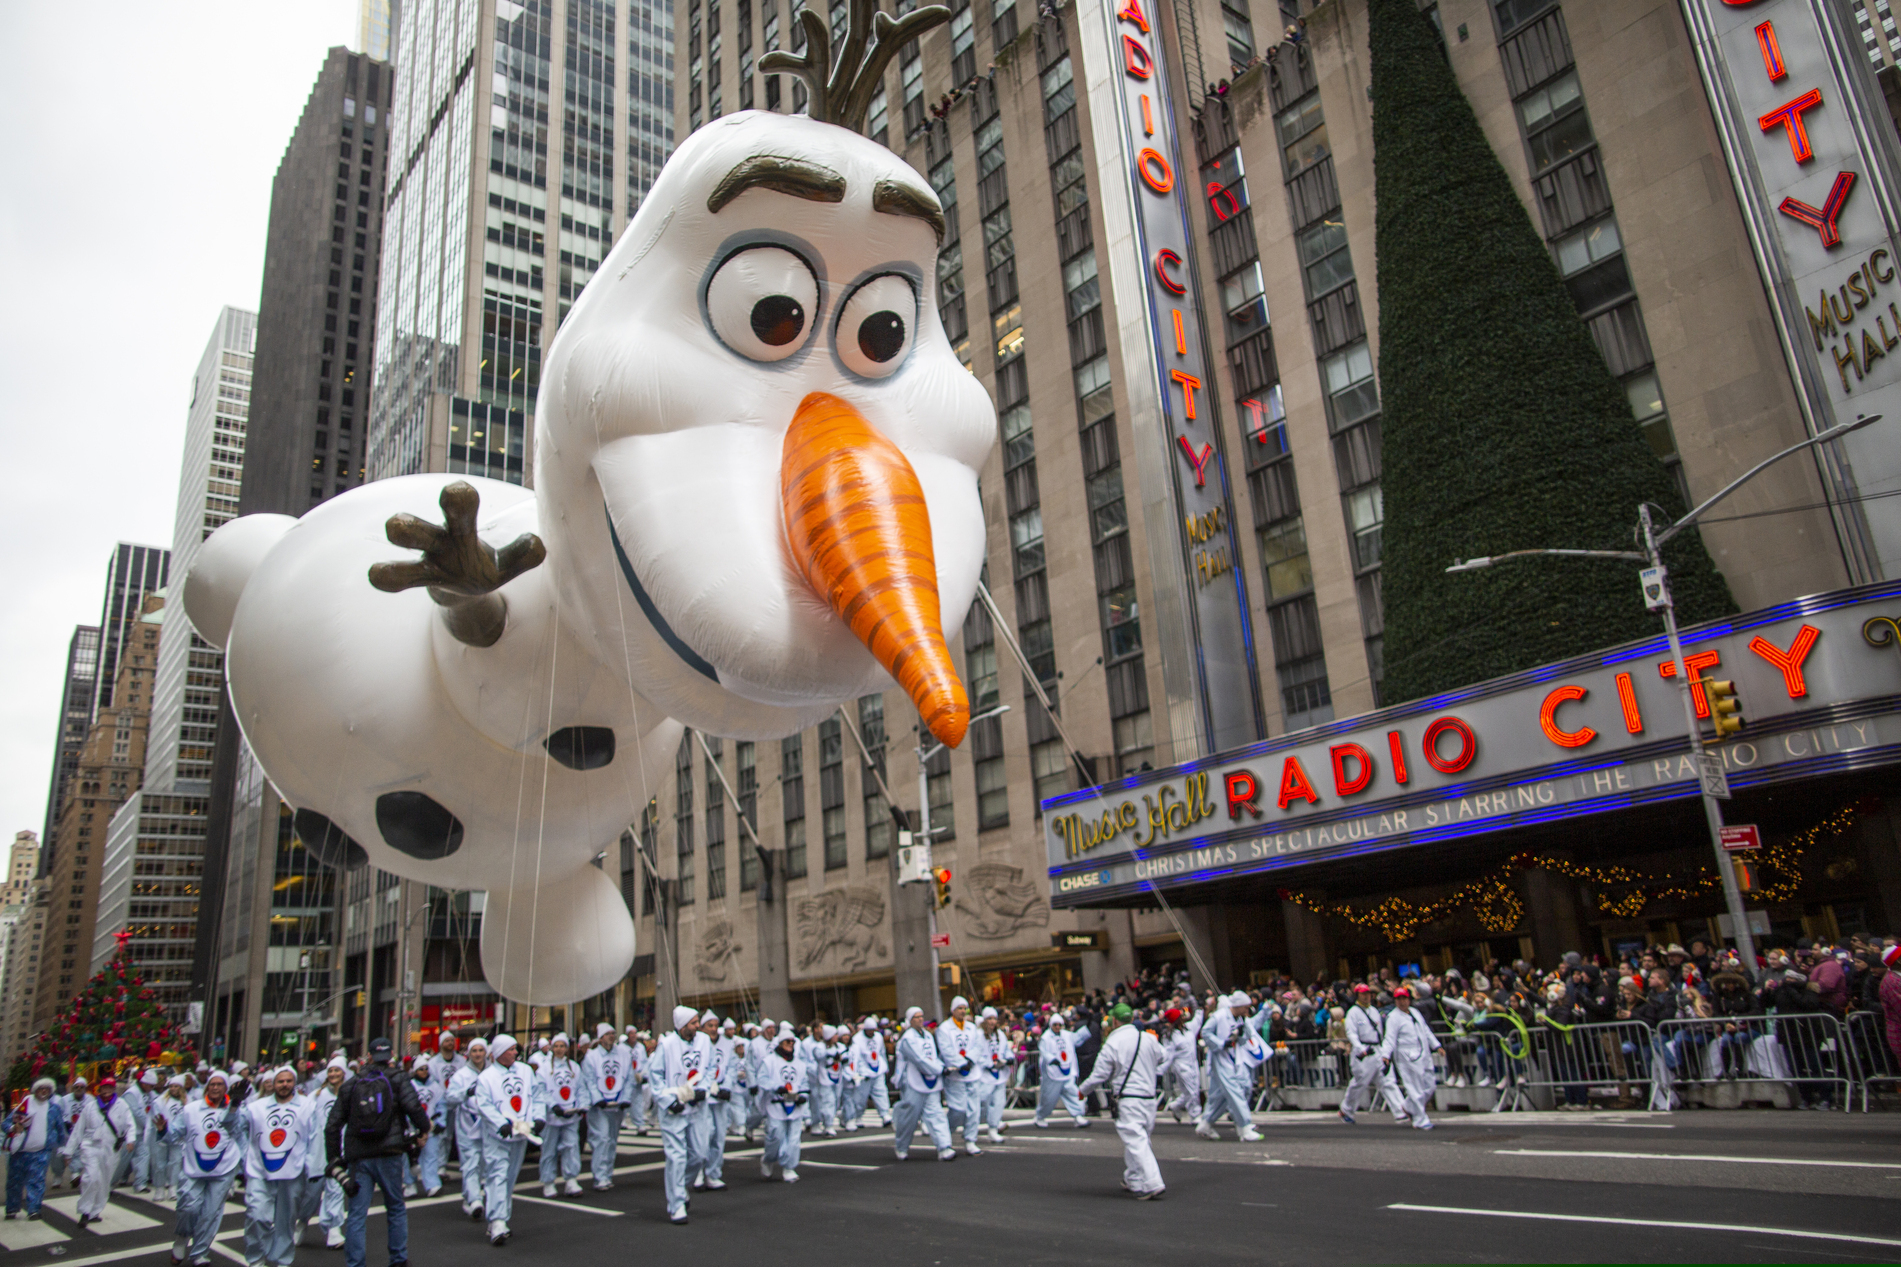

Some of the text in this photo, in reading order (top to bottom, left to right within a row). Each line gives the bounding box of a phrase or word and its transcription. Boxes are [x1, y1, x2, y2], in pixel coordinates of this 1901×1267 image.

[1719, 0, 1857, 250] ITY
[1805, 248, 1895, 352] MUSIC
[1154, 247, 1212, 488] CITY
[1186, 506, 1224, 549] MUSIC
[1195, 546, 1230, 588] HALL
[1223, 624, 1821, 820] RADIO CITY
[1053, 771, 1216, 860] Music Hall
[1134, 843, 1237, 879] CHRISTMAS
[1250, 809, 1409, 859] SPECTACULAR
[1425, 781, 1554, 826] STARRING
[1576, 765, 1631, 795] THE
[1653, 742, 1758, 782] RAIO
[1785, 721, 1867, 757] CITY
[1059, 872, 1100, 892] CHASE
